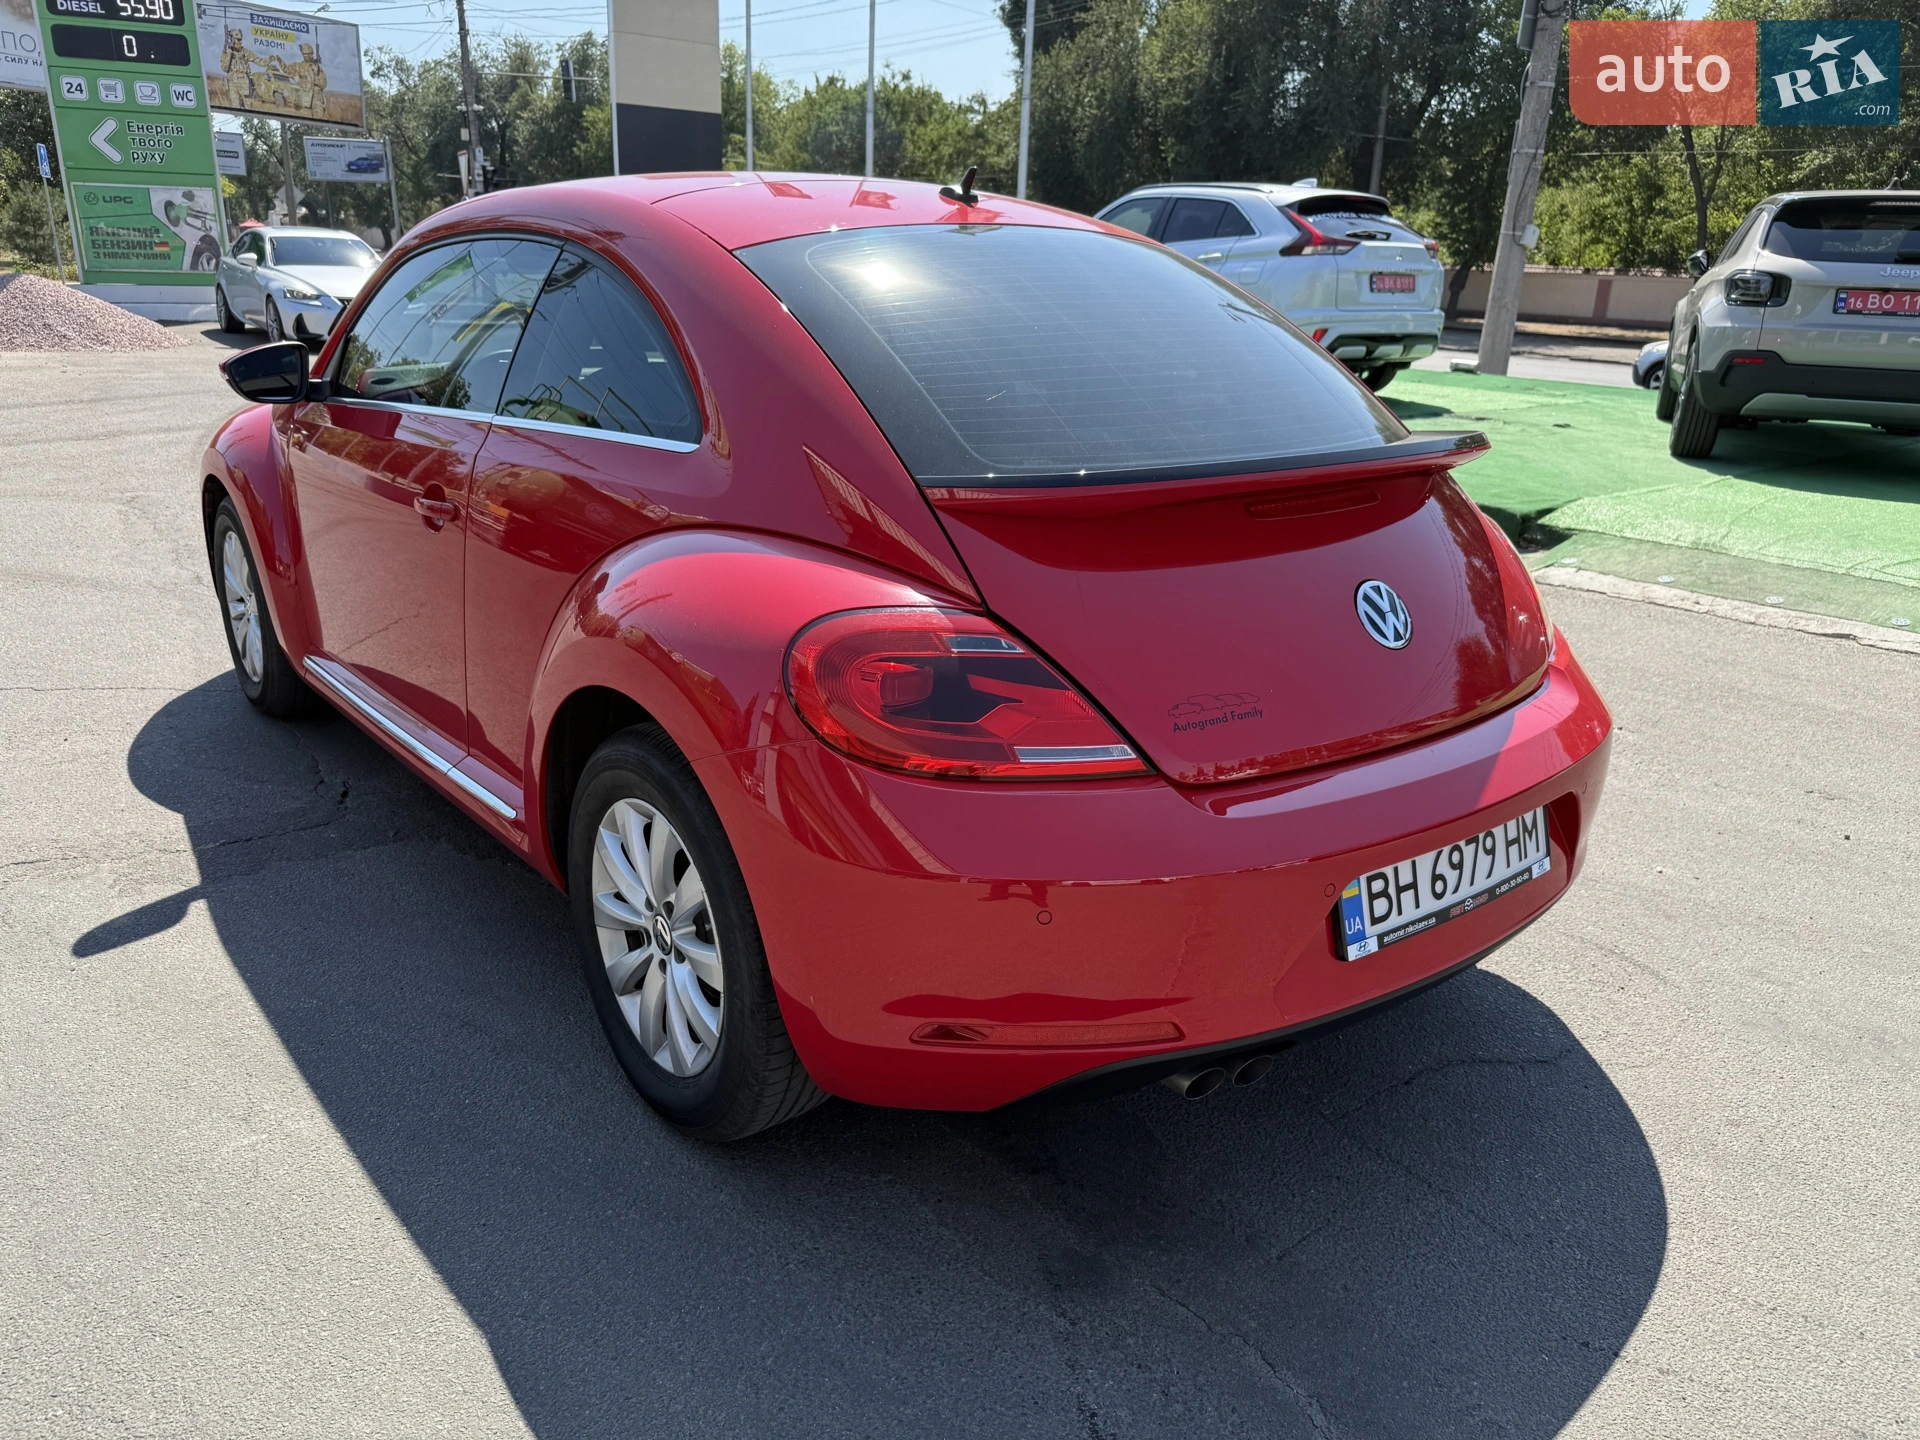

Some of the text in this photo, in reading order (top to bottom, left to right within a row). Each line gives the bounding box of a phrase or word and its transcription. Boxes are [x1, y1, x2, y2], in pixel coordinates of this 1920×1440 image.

[57, 0, 174, 20] DIESEL 55.90
[252, 14, 308, 32] ЗАХИЩАЄМО
[253, 26, 290, 41] УКРАЇНУ
[253, 37, 286, 50] РАЗОМ!
[4, 56, 29, 65] СИЛУ
[65, 82, 84, 95] 24
[173, 89, 194, 102] WC
[127, 120, 185, 137] Енергія
[129, 137, 173, 149] твого
[131, 150, 166, 164] руху
[102, 195, 134, 205] UPG
[91, 238, 155, 251] БЕНЗИН
[103, 251, 171, 261] НІМЕЧЧИНИ
[1848, 297, 1863, 309] 16
[1867, 293, 1895, 309] BO
[1173, 706, 1264, 733] Autogrand Family
[1345, 810, 1541, 935] UA BH 6979 HM
